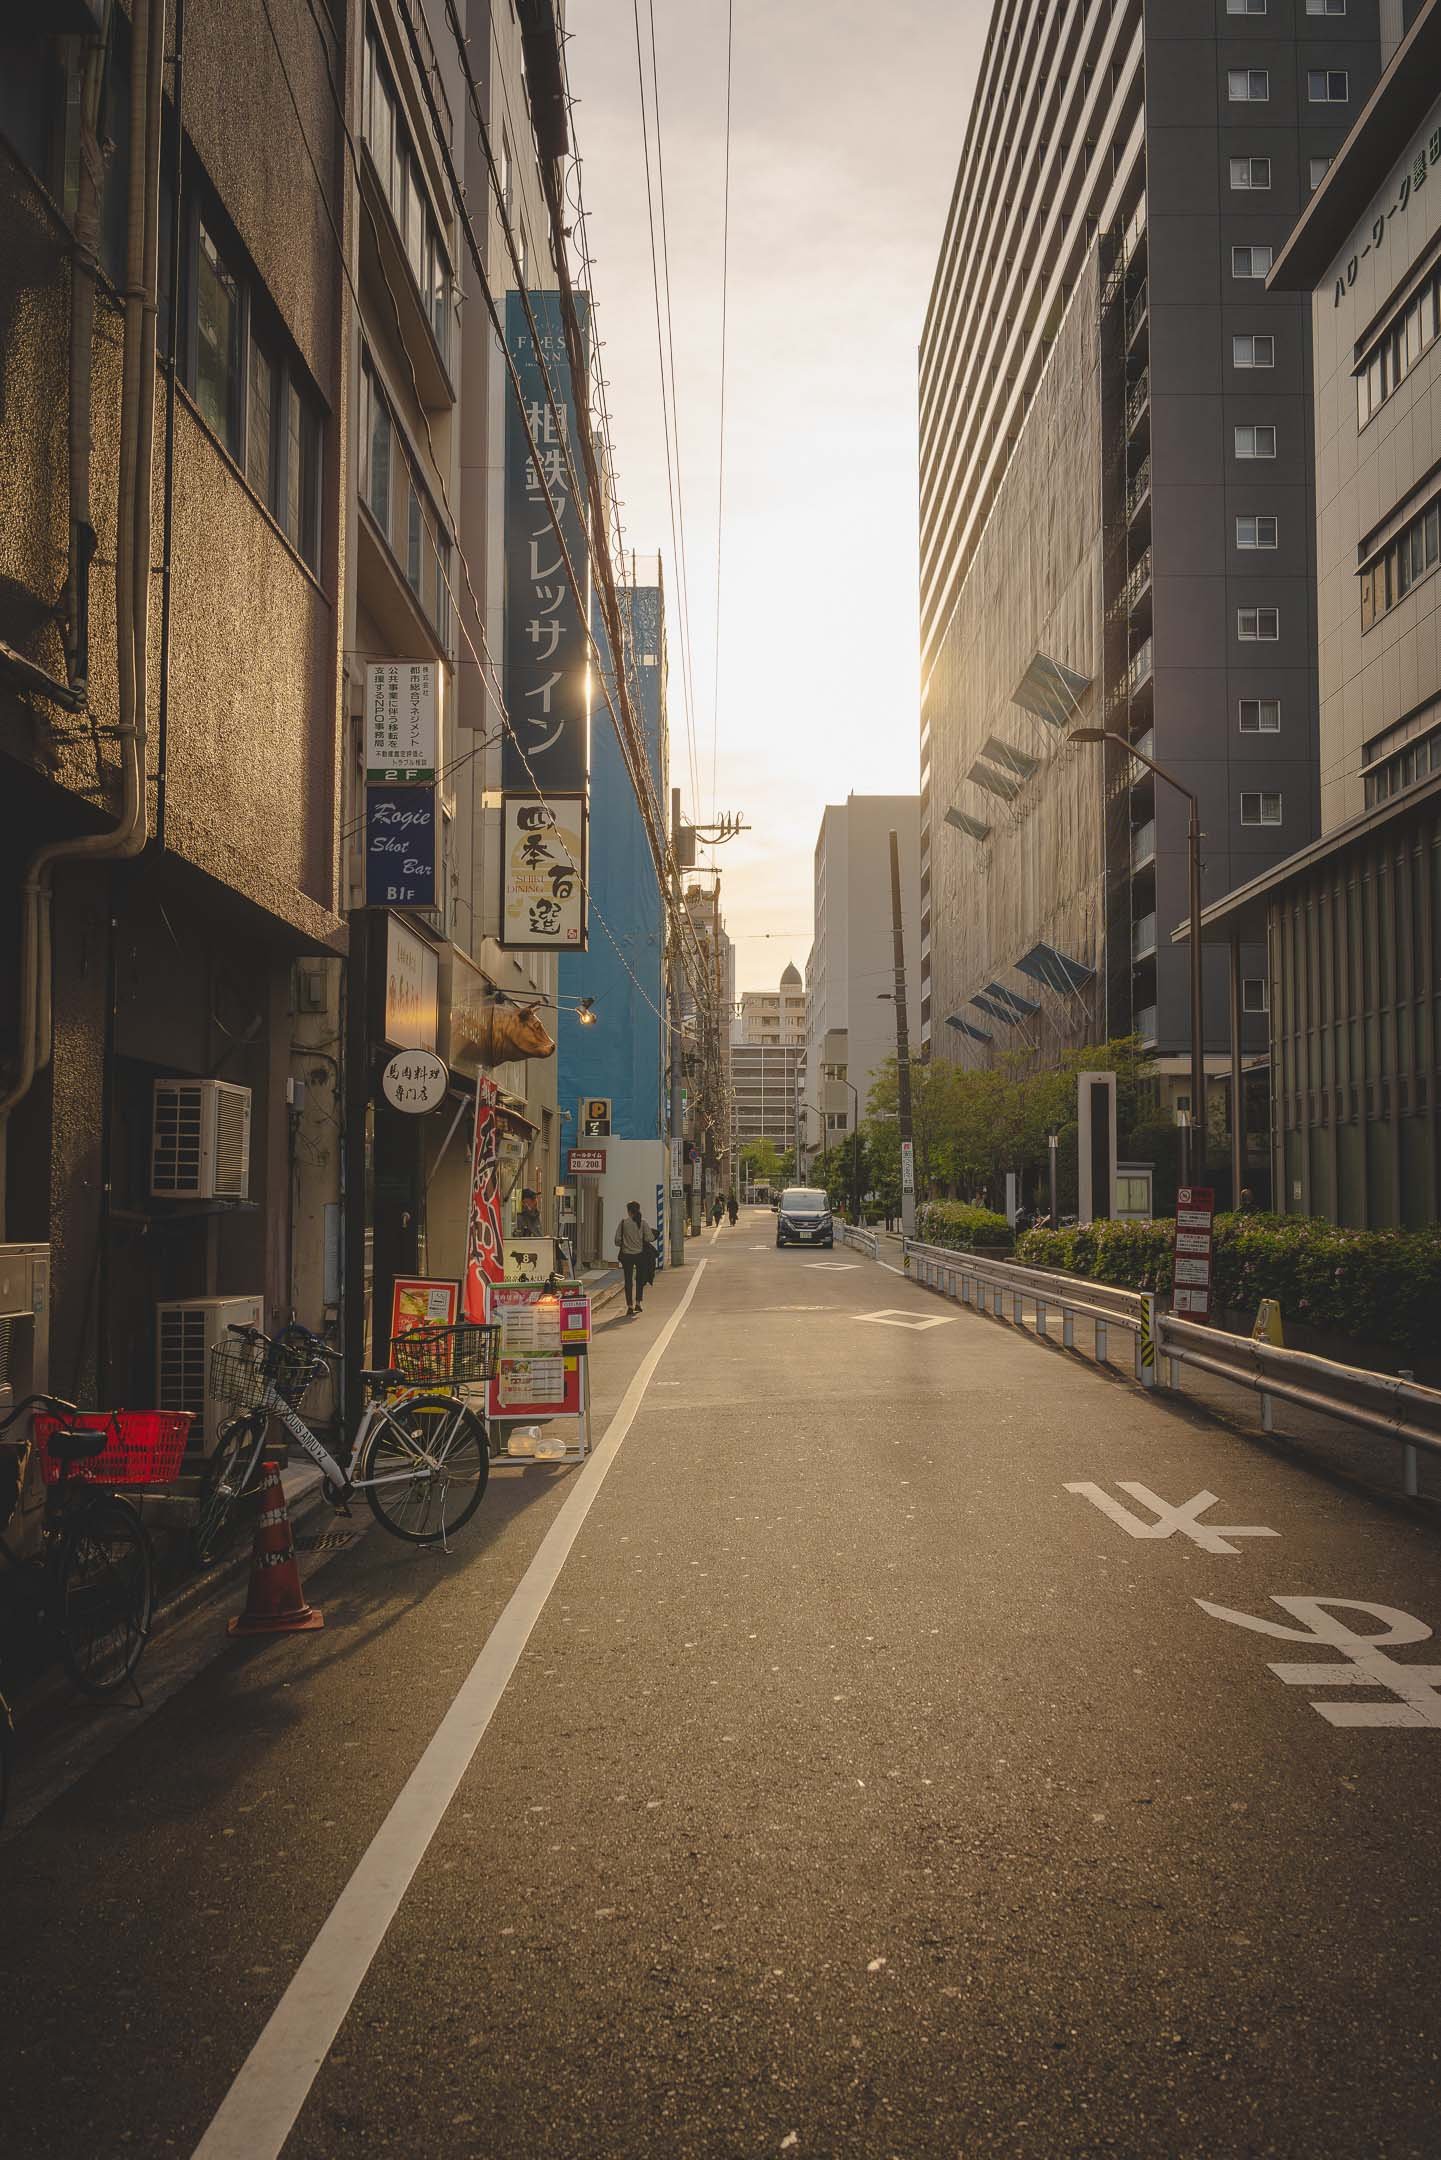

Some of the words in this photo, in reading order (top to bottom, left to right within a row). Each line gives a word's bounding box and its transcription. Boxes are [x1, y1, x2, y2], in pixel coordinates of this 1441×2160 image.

[1335, 127, 1441, 308] ハローワーク墨田
[525, 401, 568, 755] 相鉄フレッサイン
[374, 667, 384, 748] 支援するNPO事務局
[388, 666, 398, 748] 公共事業に伴う移転を
[410, 666, 420, 747] 都市総合マネジメント
[370, 836, 410, 853] Shot
[402, 858, 432, 875] Bar
[386, 1063, 440, 1082] 馬肉料理
[395, 1084, 428, 1102] 専門店
